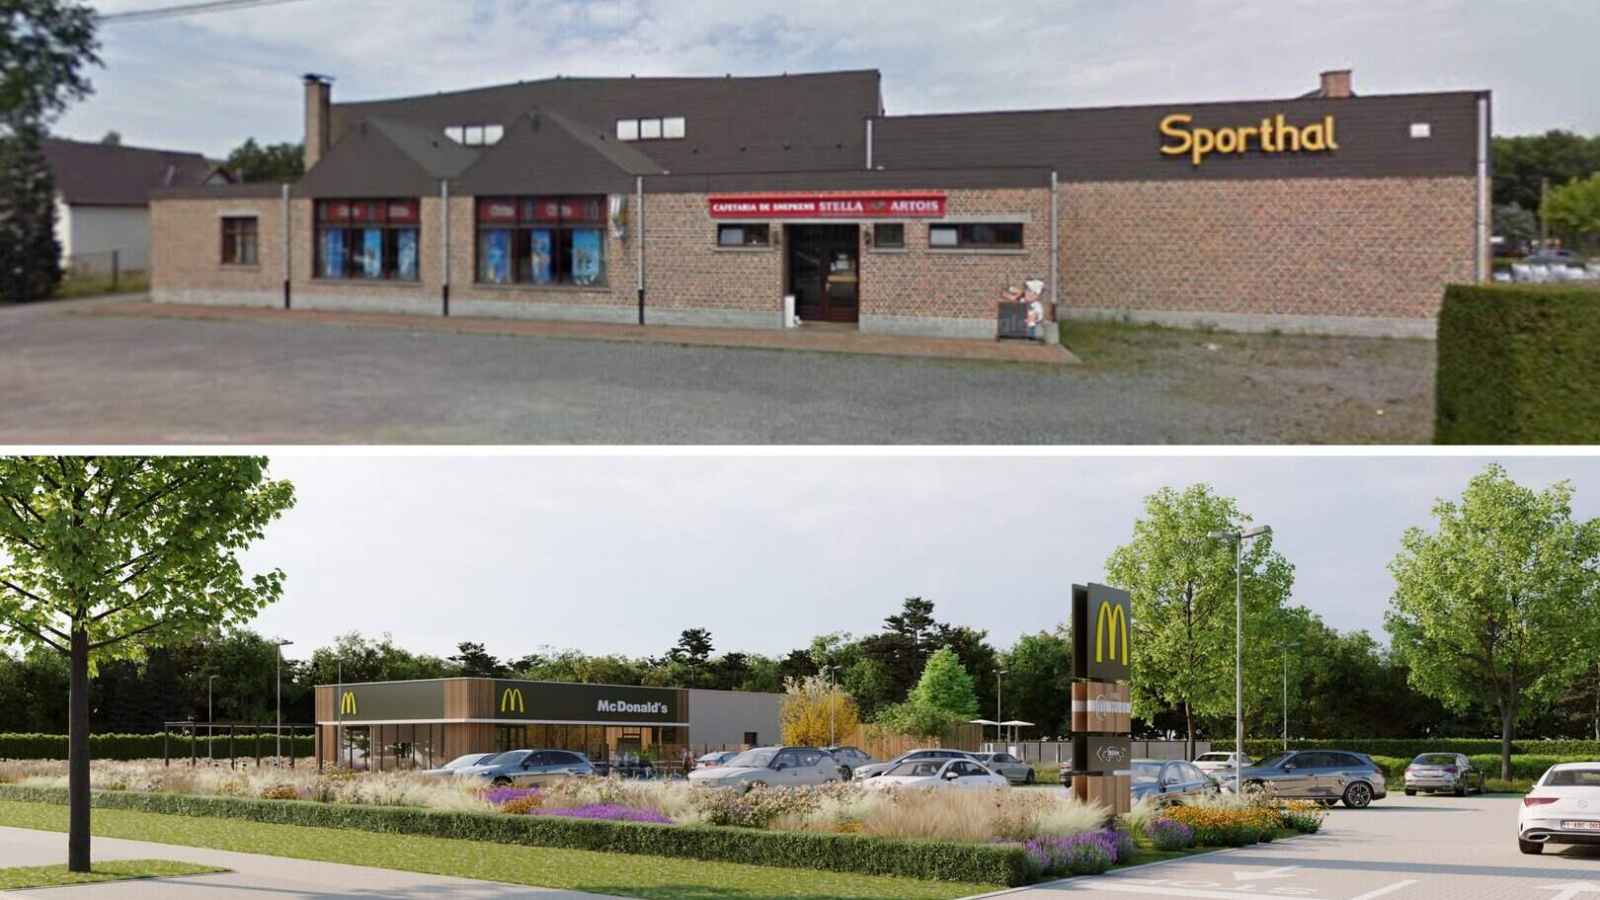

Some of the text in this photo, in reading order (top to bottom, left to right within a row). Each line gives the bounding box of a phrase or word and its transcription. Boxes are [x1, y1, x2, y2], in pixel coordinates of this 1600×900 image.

[1160, 114, 1339, 165] Sporthal
[759, 203, 771, 211] DE
[819, 200, 939, 212] STELLA ARTOIS
[597, 699, 668, 714] McDonald's
